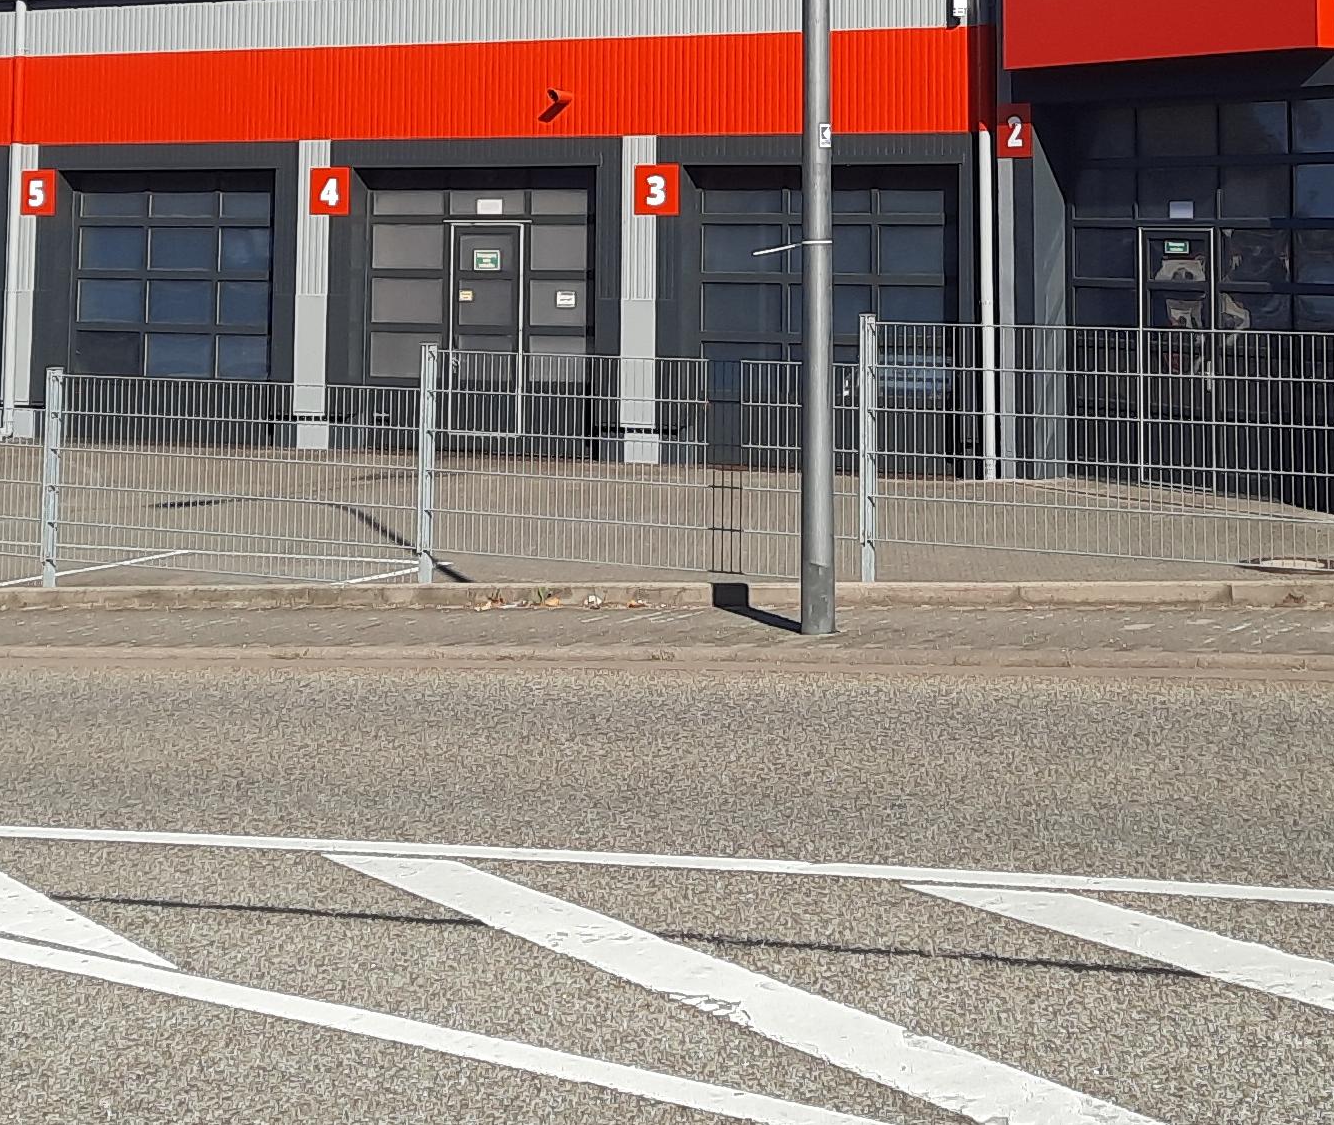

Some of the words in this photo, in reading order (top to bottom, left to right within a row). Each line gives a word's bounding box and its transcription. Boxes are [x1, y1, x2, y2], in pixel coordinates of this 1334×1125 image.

[1007, 115, 1023, 148] 2
[28, 179, 46, 208] 5
[319, 178, 340, 207] 4
[646, 175, 666, 207] 3
